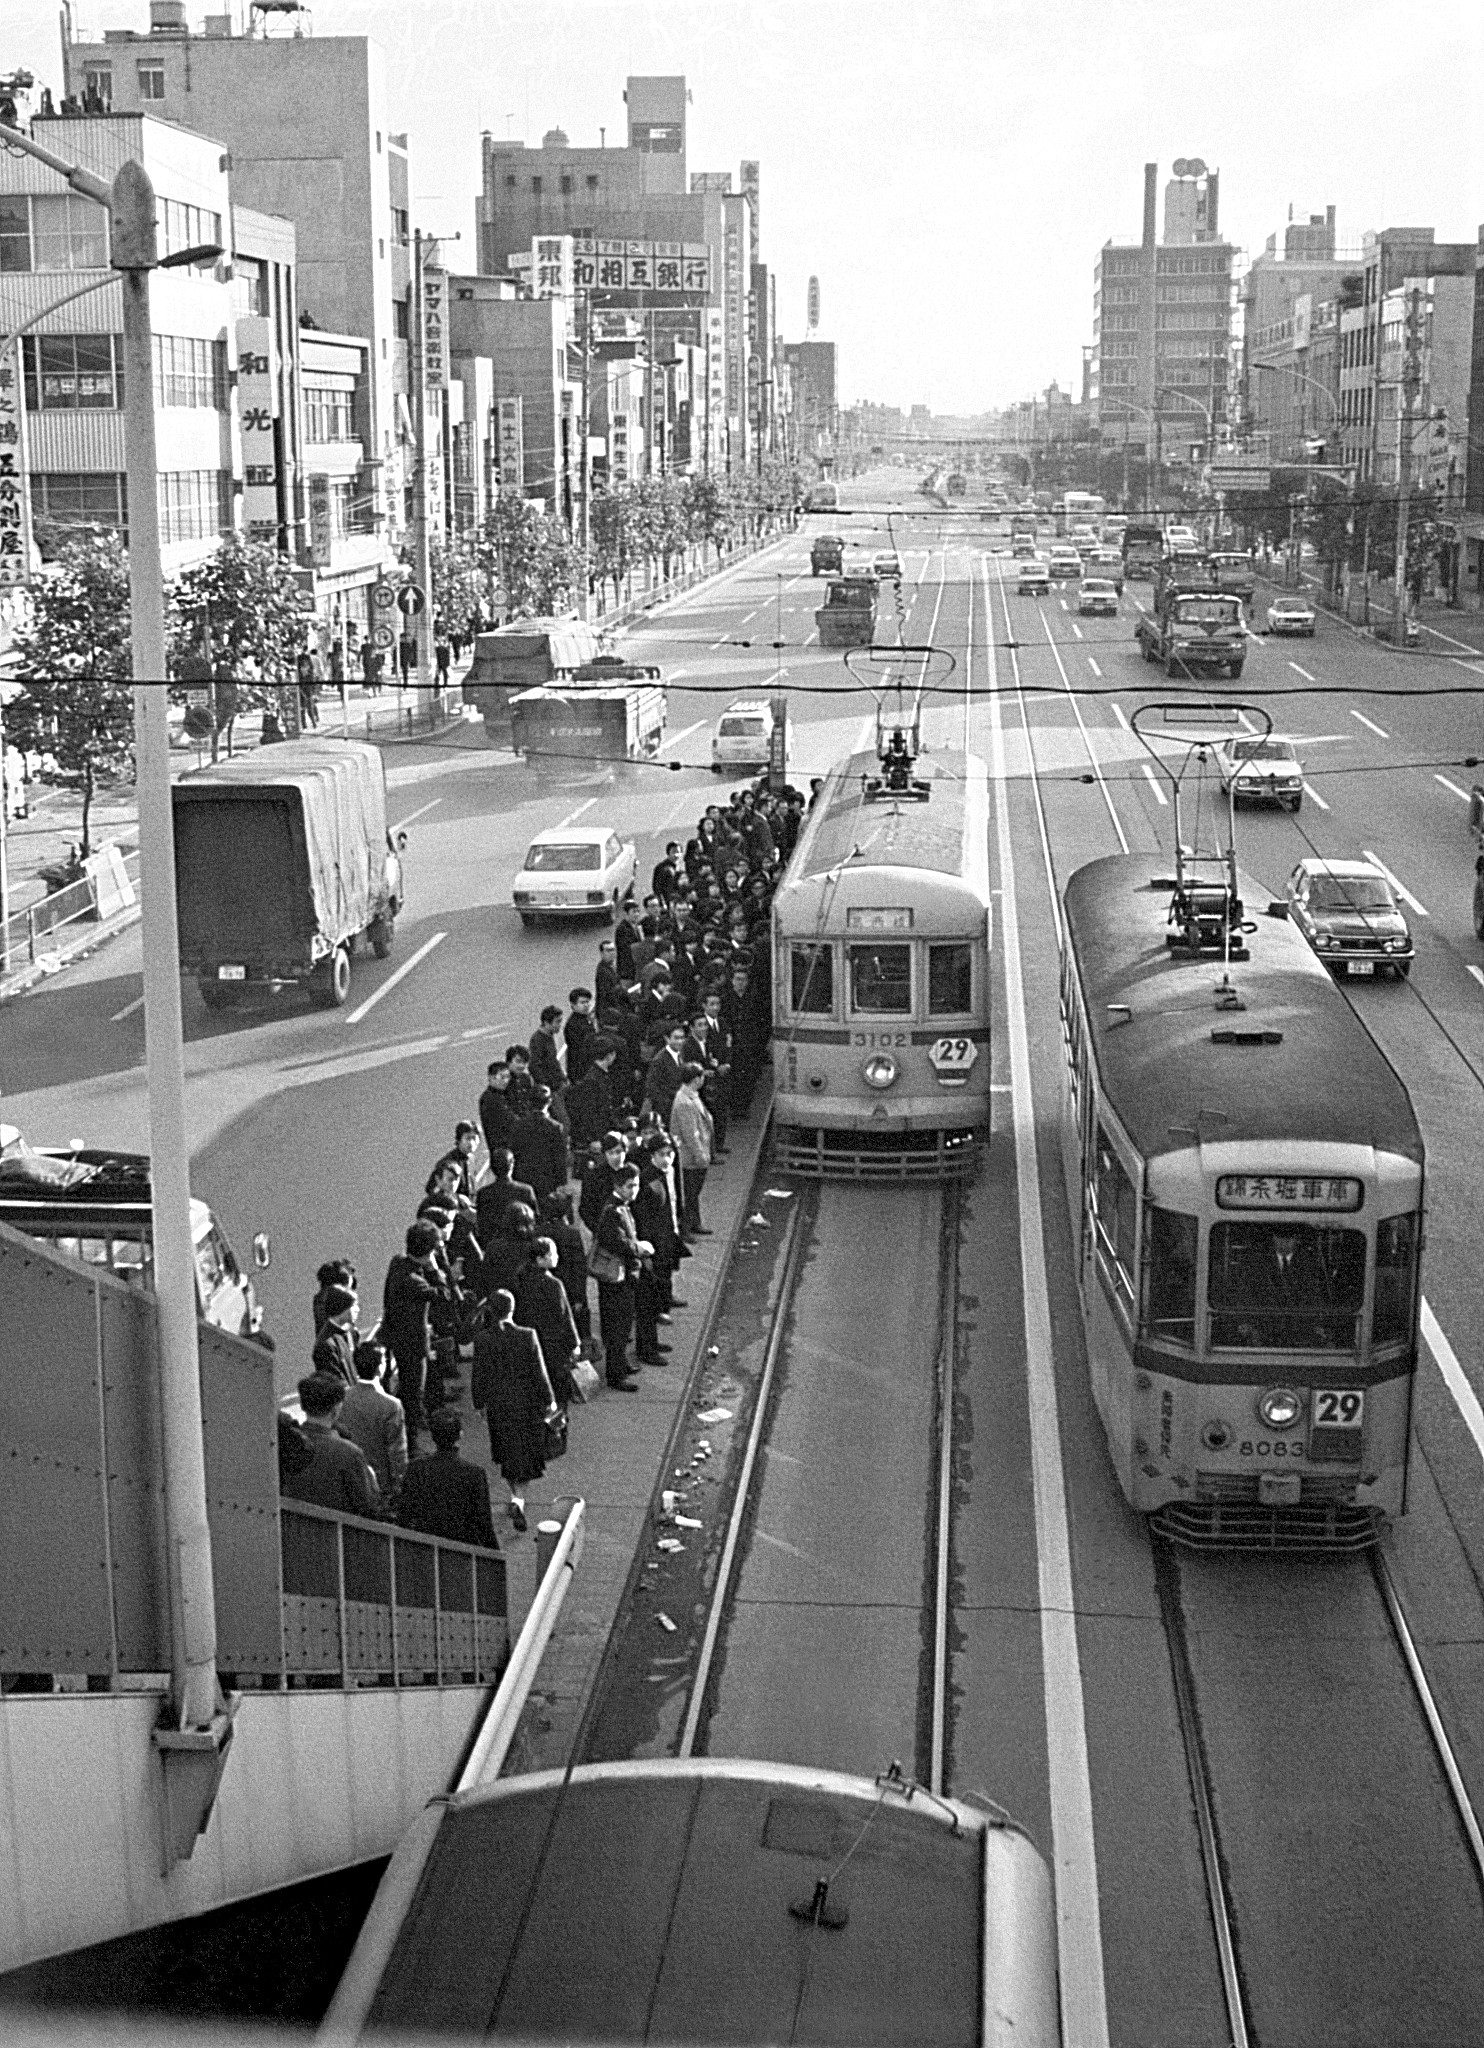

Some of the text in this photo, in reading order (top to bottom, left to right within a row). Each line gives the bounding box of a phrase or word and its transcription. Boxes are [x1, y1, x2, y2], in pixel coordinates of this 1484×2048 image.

[855, 1033, 907, 1047] 3102
[940, 1040, 968, 1060] 29
[1319, 1393, 1360, 1421] 29
[1240, 1441, 1303, 1457] 8083
